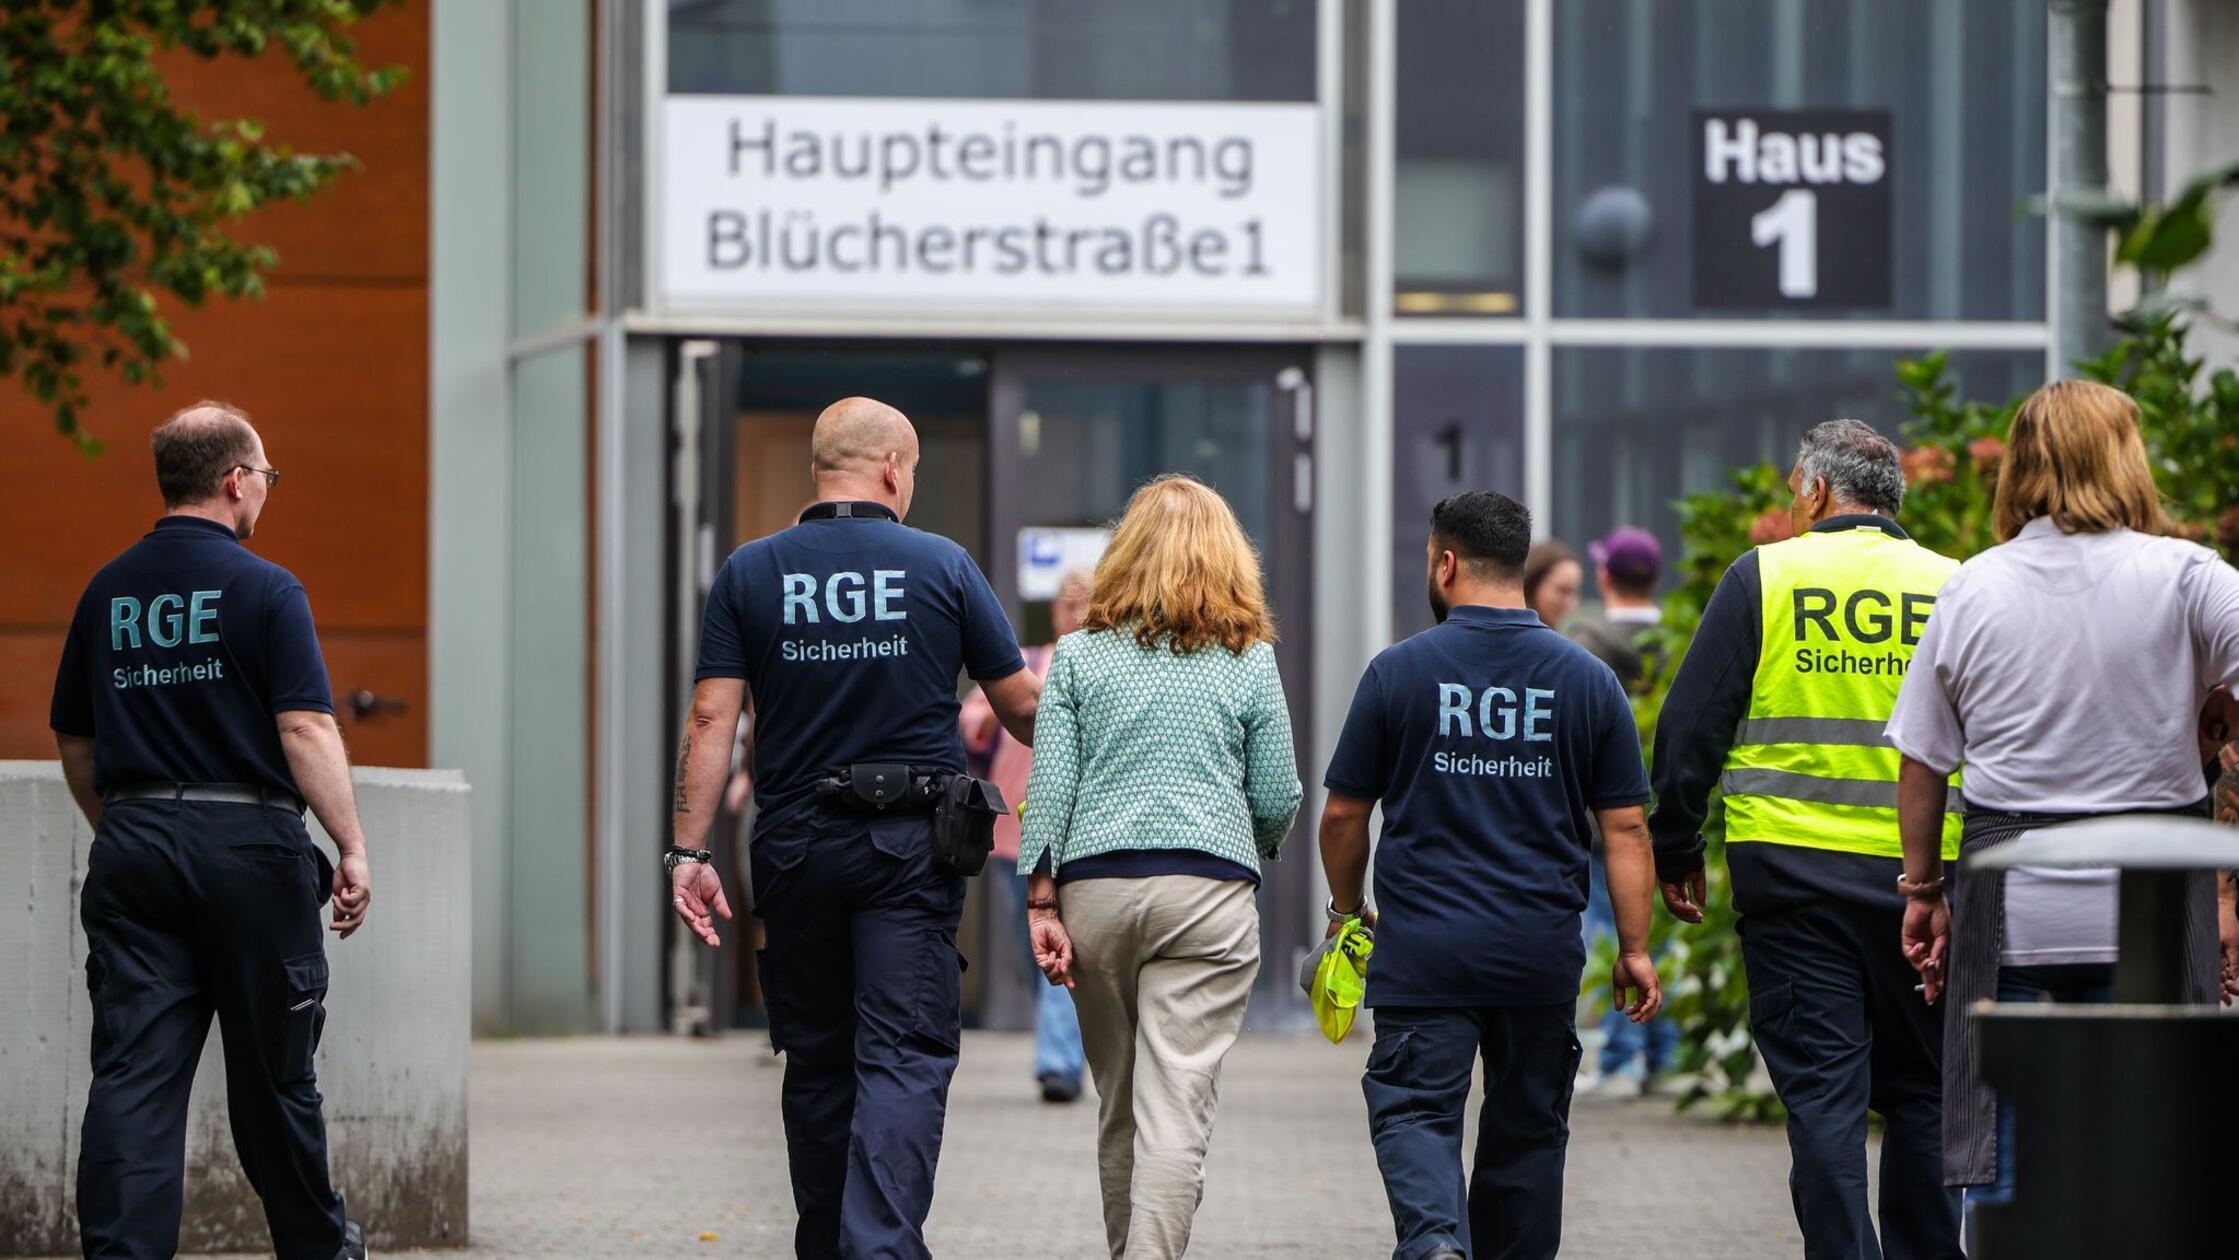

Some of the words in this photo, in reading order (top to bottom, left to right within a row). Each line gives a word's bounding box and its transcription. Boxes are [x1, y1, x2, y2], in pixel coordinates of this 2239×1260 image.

[726, 118, 1253, 198] Haupteingang
[1704, 117, 1886, 184] Haus
[1750, 188, 1818, 299] 1
[1434, 420, 1465, 484] 1
[111, 590, 222, 650] RGE
[783, 570, 907, 625] RGE
[1793, 588, 1937, 646] RGE
[113, 657, 223, 689] Sicherheit
[782, 634, 908, 661] Sicherheit
[1795, 648, 1910, 676] Sicherh
[1439, 682, 1555, 742] RGE
[1434, 751, 1552, 777] Sicherheit
